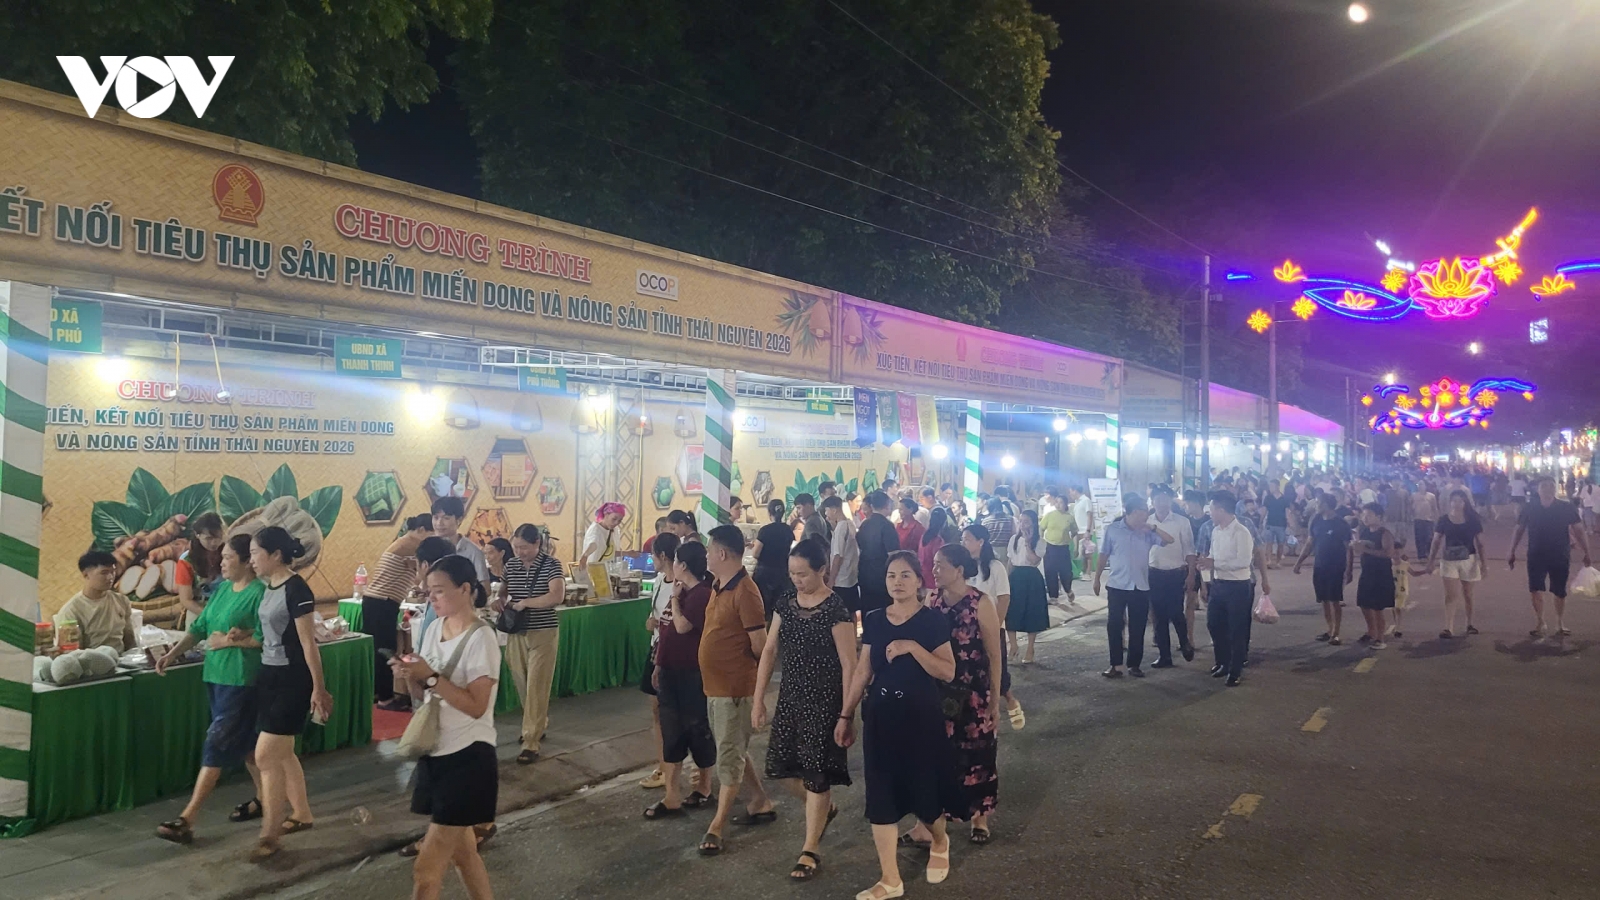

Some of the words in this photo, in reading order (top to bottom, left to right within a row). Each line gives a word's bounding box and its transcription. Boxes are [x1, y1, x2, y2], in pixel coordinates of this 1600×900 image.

[335, 203, 491, 263] CHƯƠNG
[498, 238, 592, 284] TRÌNH
[0, 186, 45, 236] ẾT
[56, 202, 121, 248] NỐI
[133, 218, 205, 260] TIÊU
[215, 232, 271, 278] THỤ
[280, 240, 336, 282] SẢN
[344, 254, 415, 294] PHẨM
[422, 269, 477, 304] MIẾN
[483, 281, 535, 313] DONG
[540, 289, 563, 317] VÀ
[567, 295, 613, 326] NÔNG
[617, 301, 648, 331] SẢN
[651, 306, 682, 337] TỈNH
[686, 317, 713, 341] THÁI
[717, 323, 763, 349] NGUYÊN
[765, 332, 791, 353] 2026
[639, 272, 676, 293] OCOP
[62, 308, 79, 323] XÃ
[57, 327, 82, 343] PHÚ
[351, 343, 374, 355] UBND
[376, 343, 387, 356] XÃ
[341, 359, 369, 370] THANH
[95, 406, 129, 425] KẾT
[134, 407, 164, 426] NỐI
[170, 410, 204, 428] TIÊU
[210, 413, 239, 432] THỤ
[243, 412, 274, 431] SẢN
[278, 413, 319, 432] PHẨM
[323, 416, 357, 433] MIẾN
[360, 421, 394, 434] DONG
[56, 431, 81, 449] VÀ
[86, 432, 138, 450] NÔNG
[143, 432, 179, 450] SẢN
[184, 433, 220, 451] TỈNH
[225, 436, 258, 452] THÁI
[263, 437, 319, 453] NGUYÊN
[324, 440, 355, 453] 2026
